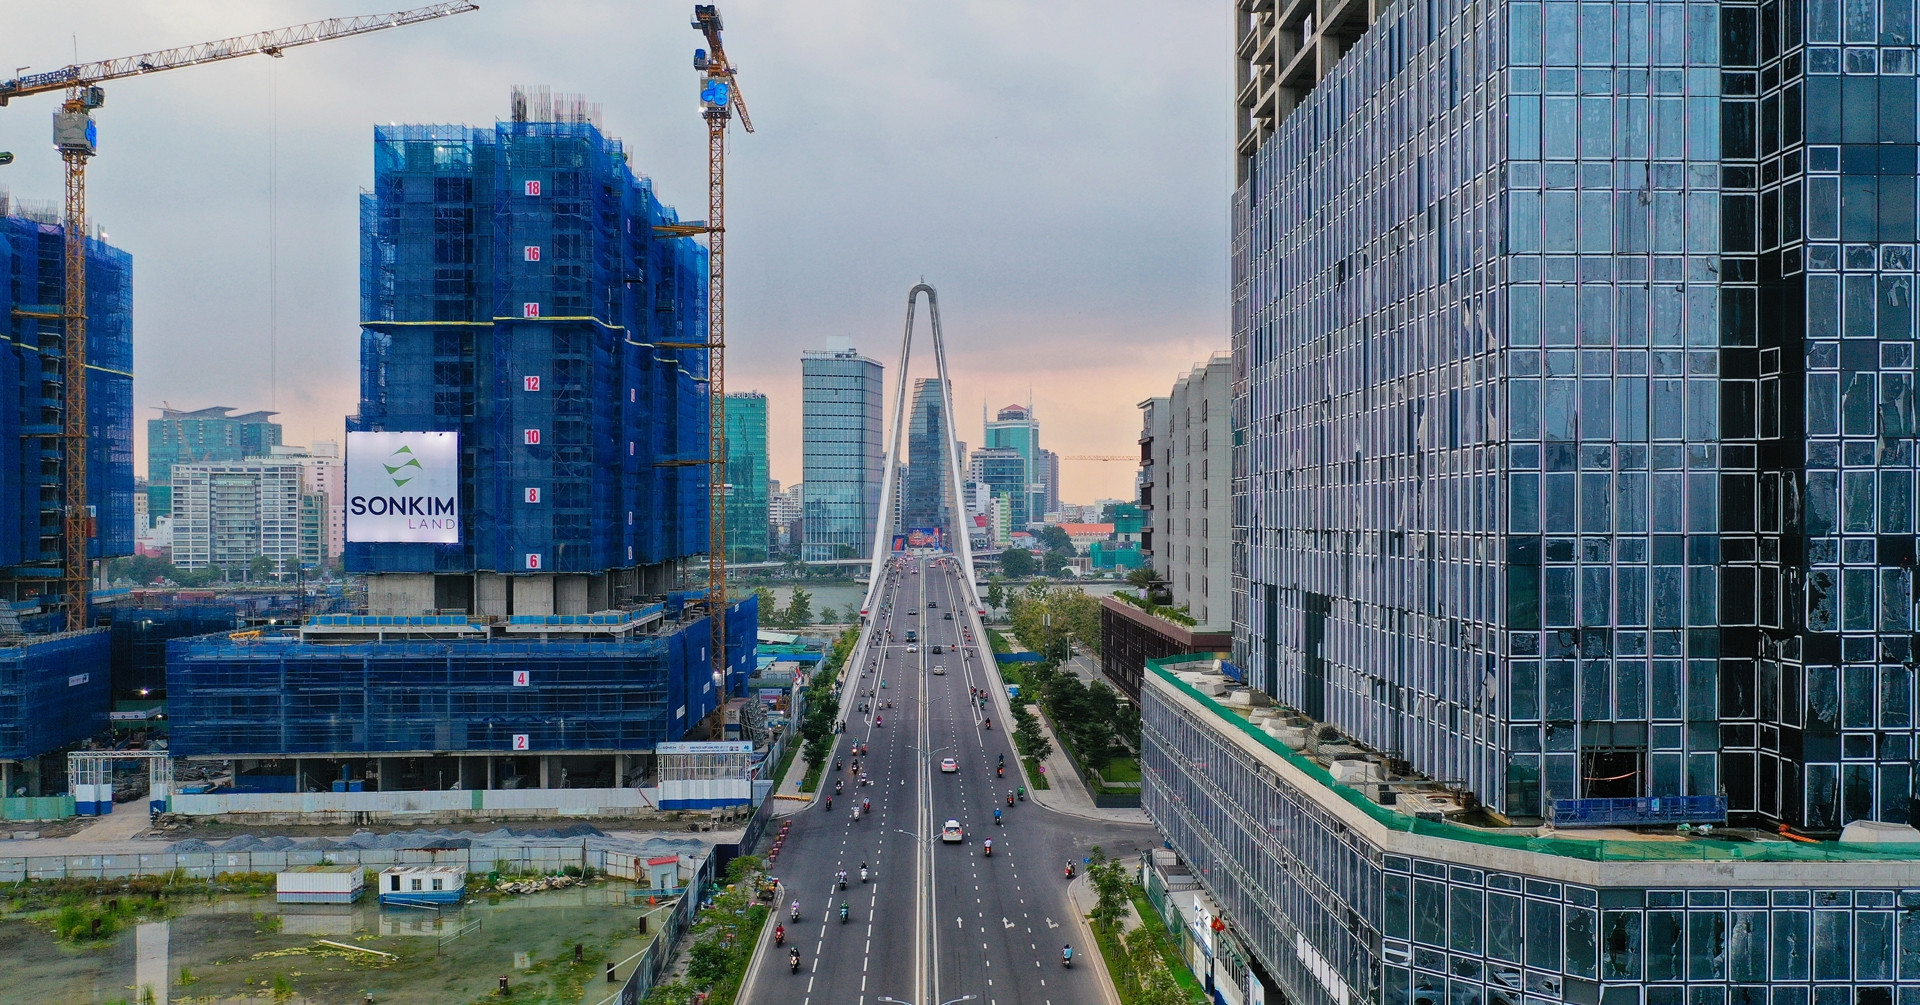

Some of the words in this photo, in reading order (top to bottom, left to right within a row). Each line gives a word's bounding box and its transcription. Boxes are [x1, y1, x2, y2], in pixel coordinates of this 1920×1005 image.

[527, 182, 540, 195] 18
[526, 247, 539, 261] 16
[525, 303, 538, 316] 14
[525, 377, 539, 390] 12
[526, 430, 539, 444] 10
[529, 488, 537, 502] 8
[350, 495, 455, 516] SONKIM
[408, 518, 456, 530] LAND
[530, 555, 538, 568] 6
[517, 672, 525, 685] 4
[517, 736, 524, 749] 2
